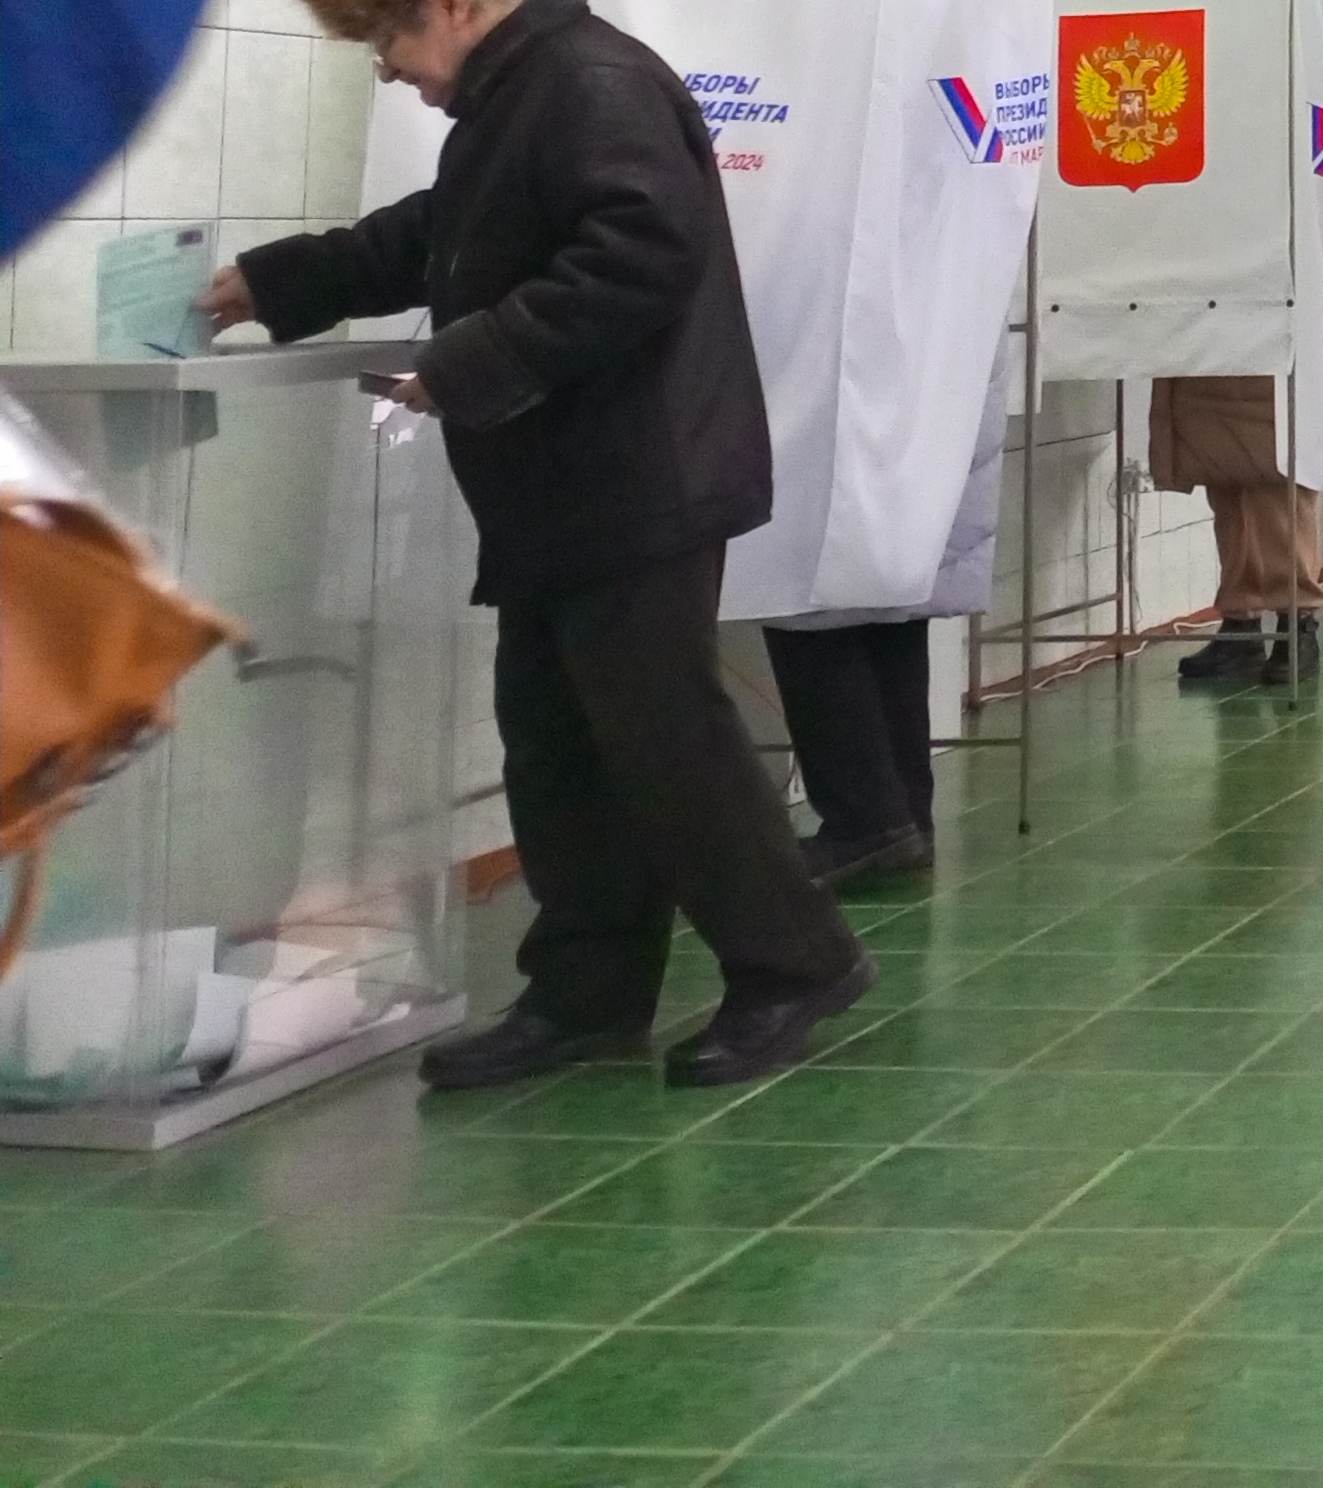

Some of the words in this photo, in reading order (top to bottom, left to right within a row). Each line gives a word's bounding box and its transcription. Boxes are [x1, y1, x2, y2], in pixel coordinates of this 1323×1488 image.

[684, 73, 761, 95] БОРЫ
[701, 100, 789, 123] ИДЕНТА
[996, 98, 1048, 124] ПРЕЗИД
[721, 153, 764, 171] 2024
